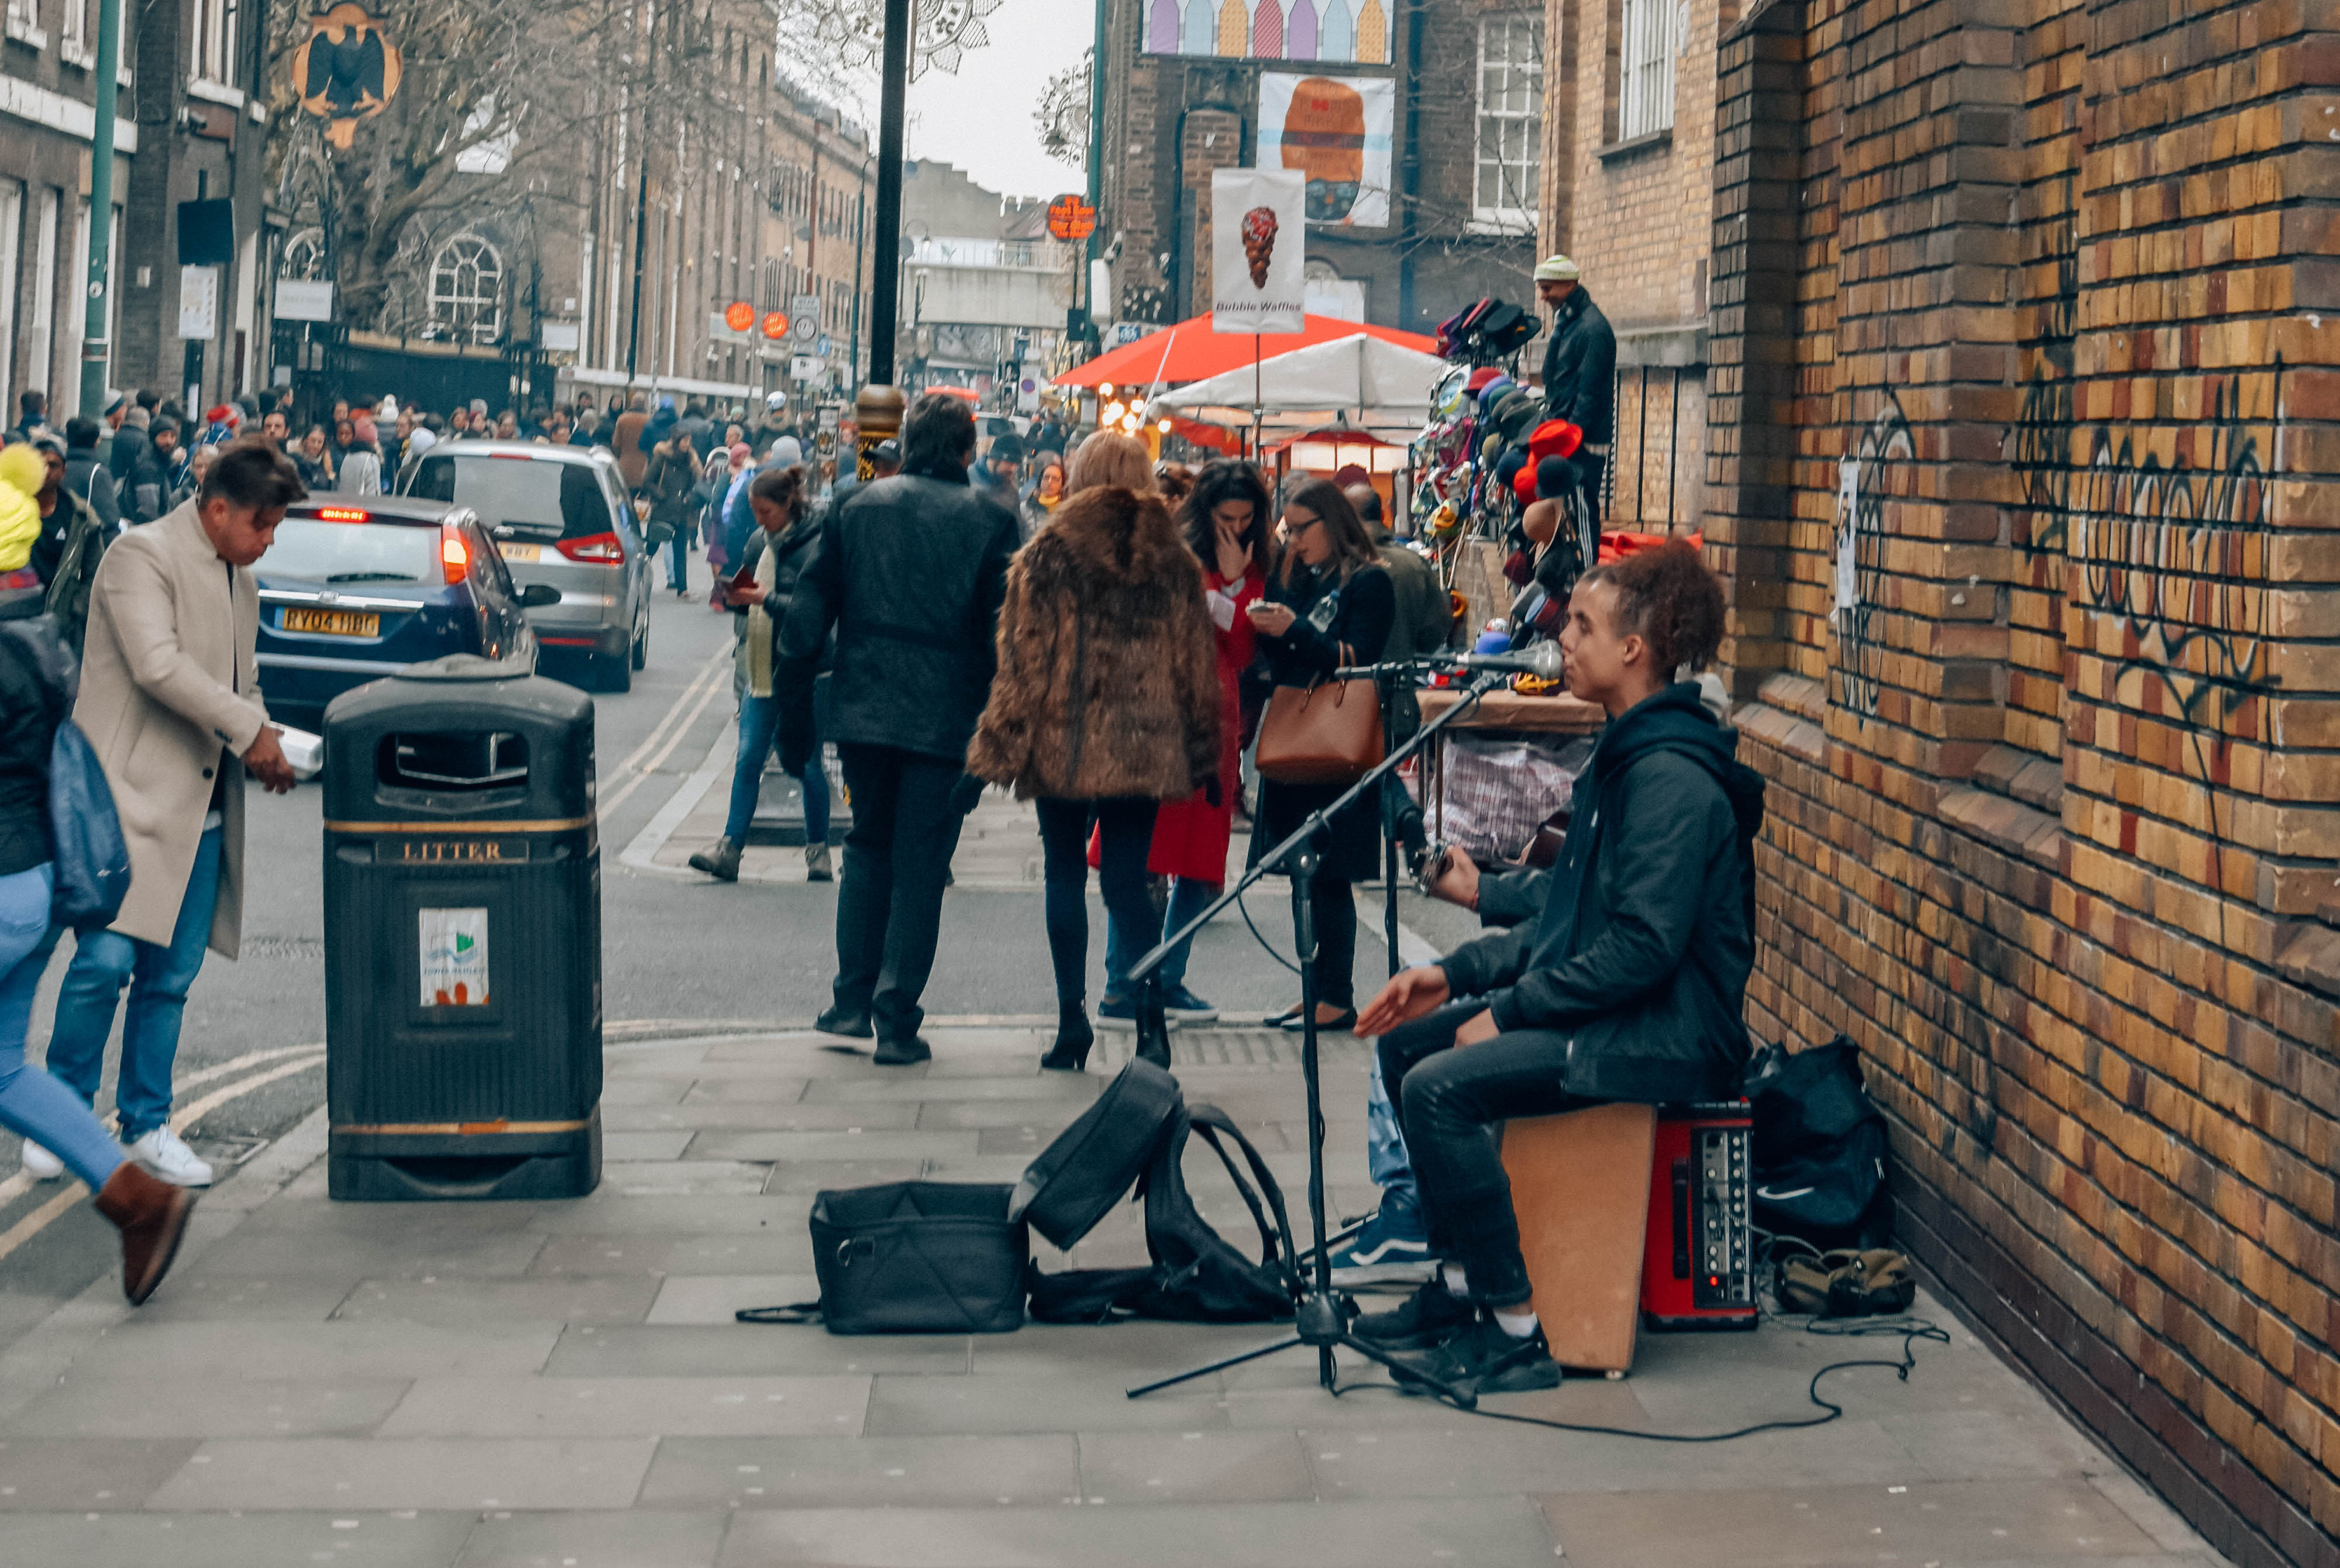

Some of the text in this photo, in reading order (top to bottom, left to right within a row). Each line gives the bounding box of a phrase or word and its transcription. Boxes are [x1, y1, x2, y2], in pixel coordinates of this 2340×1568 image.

[1216, 301, 1302, 312] Bubble Waffles
[404, 842, 500, 861] LITTER
